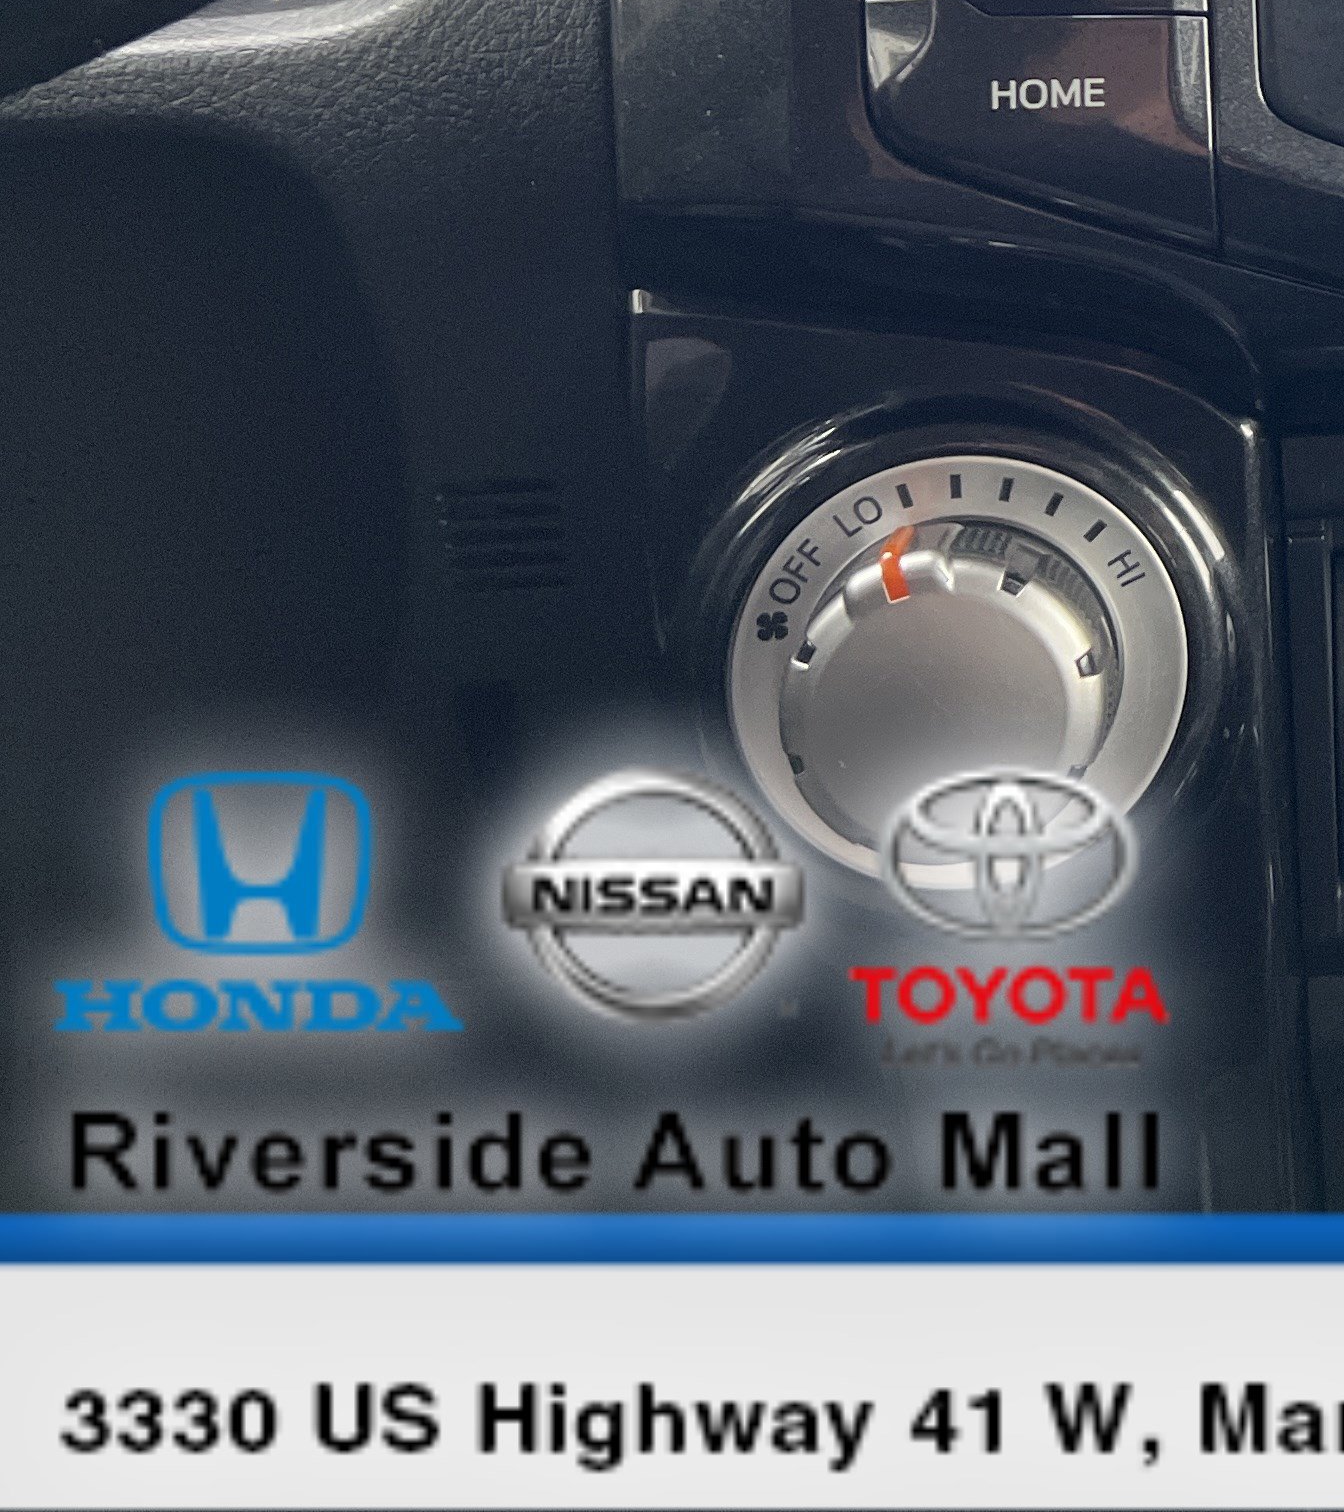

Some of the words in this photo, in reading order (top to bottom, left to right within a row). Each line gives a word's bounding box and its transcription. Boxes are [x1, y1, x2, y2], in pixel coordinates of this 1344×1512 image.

[990, 79, 1106, 110] HOME
[832, 494, 883, 539] LO
[768, 537, 824, 605] OFF
[1106, 548, 1146, 589] HI
